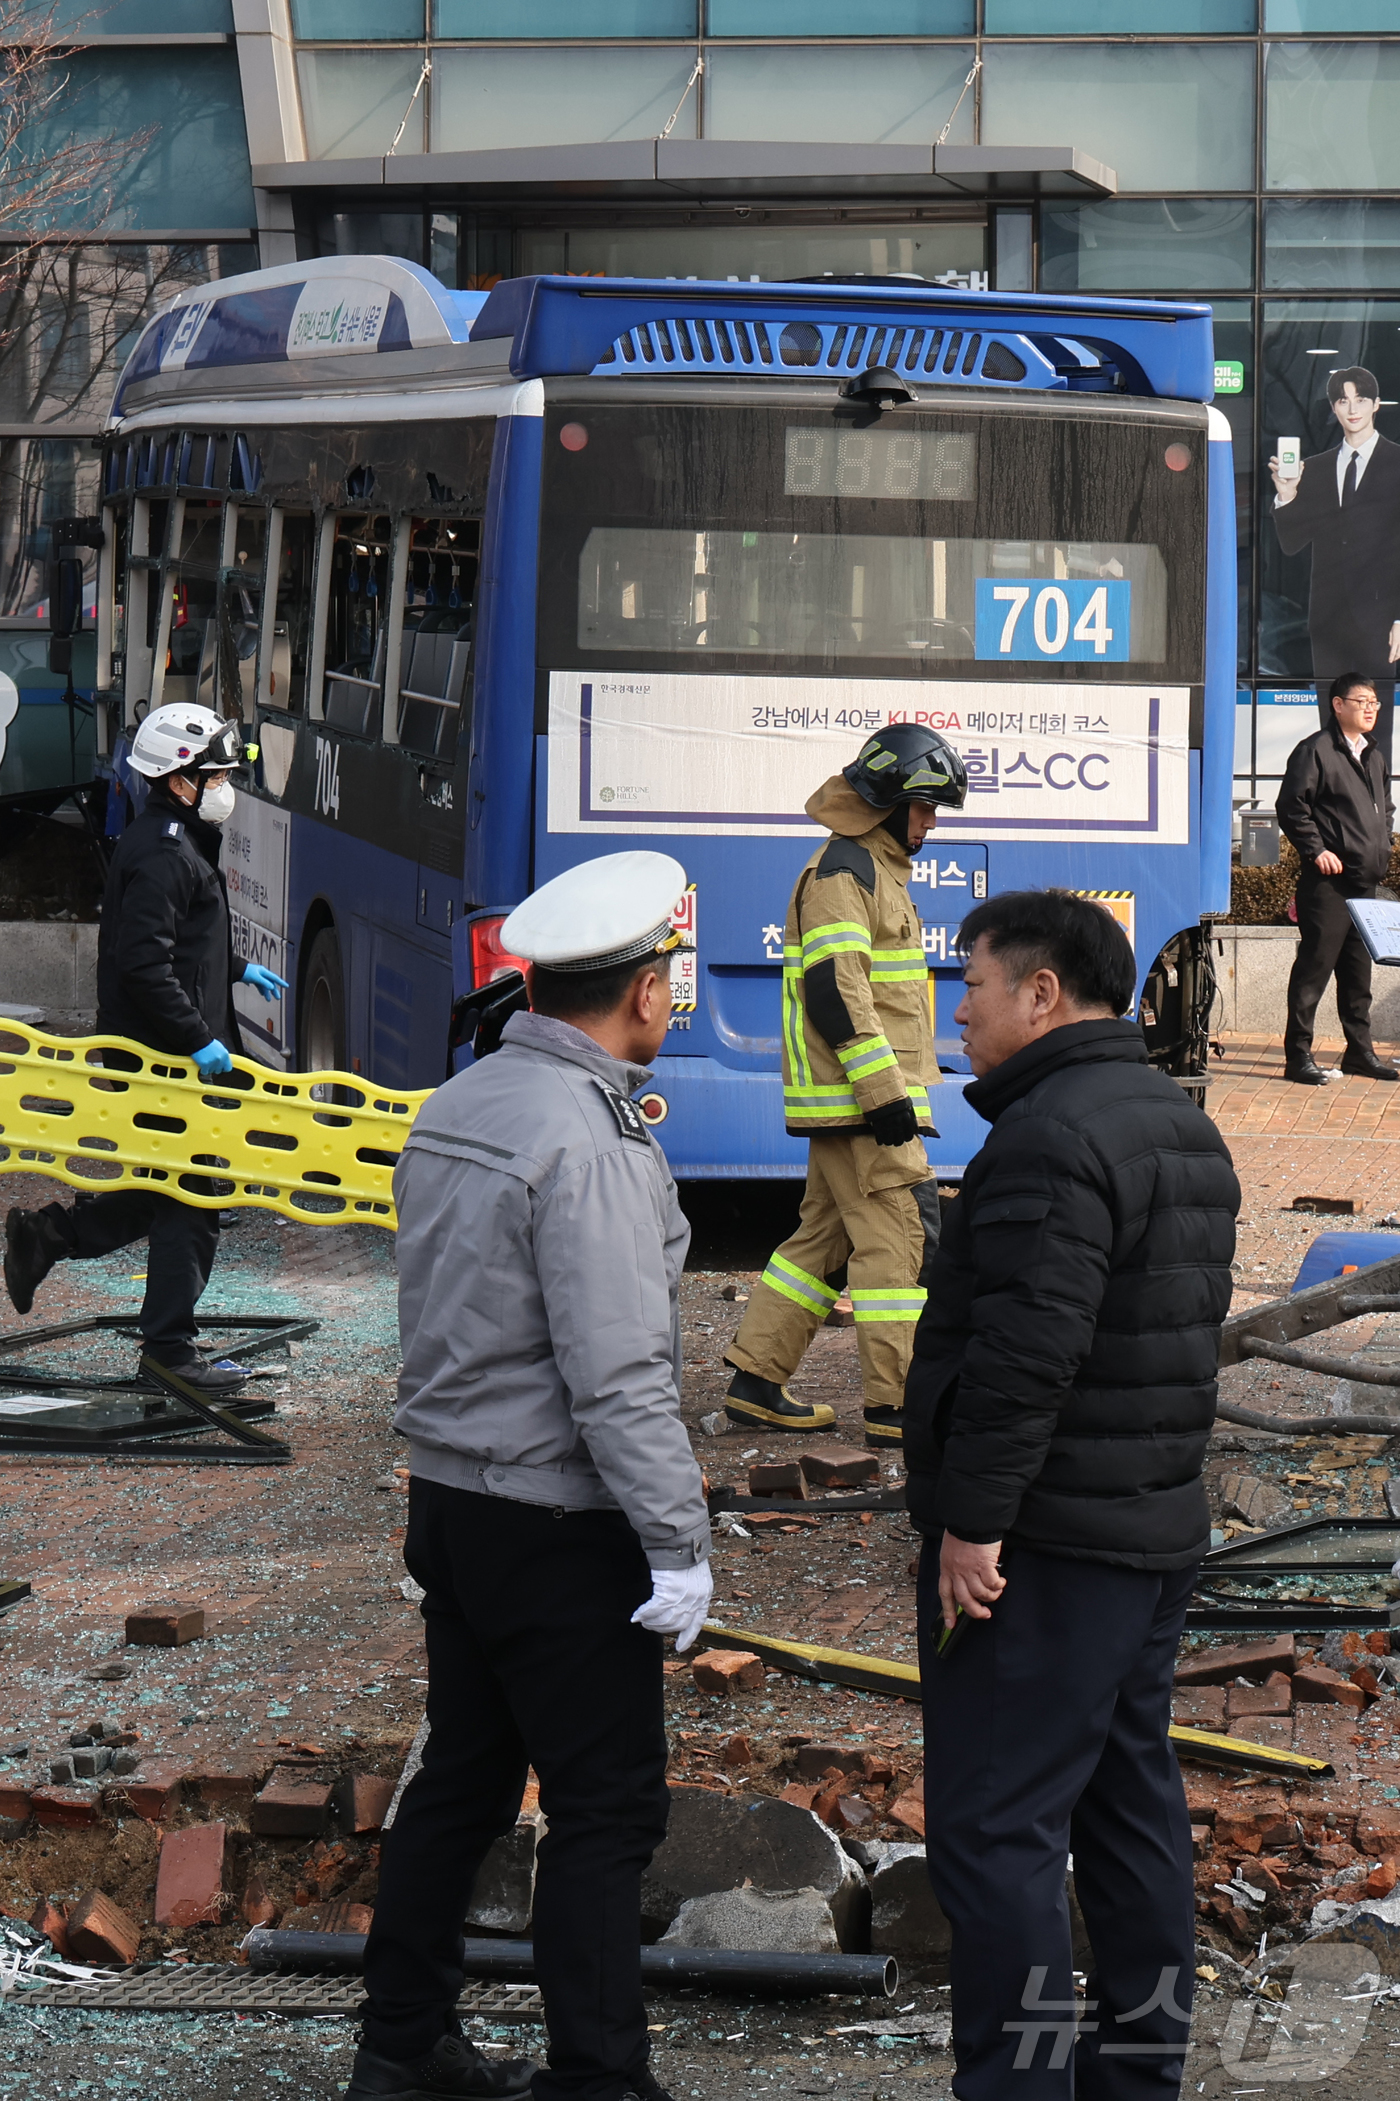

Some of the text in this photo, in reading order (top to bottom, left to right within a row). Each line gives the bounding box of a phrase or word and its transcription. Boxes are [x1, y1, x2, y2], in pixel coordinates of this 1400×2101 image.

[992, 585, 1114, 655] 704
[751, 705, 829, 730] 강남에서
[834, 708, 883, 731] 40분
[967, 711, 1023, 734] 메이저
[1029, 712, 1066, 735] 대회
[1072, 715, 1110, 734] 코스
[314, 735, 340, 820] 704
[952, 747, 1111, 794] 힐스CC
[667, 894, 693, 932] 의
[670, 981, 693, 999] 려요!
